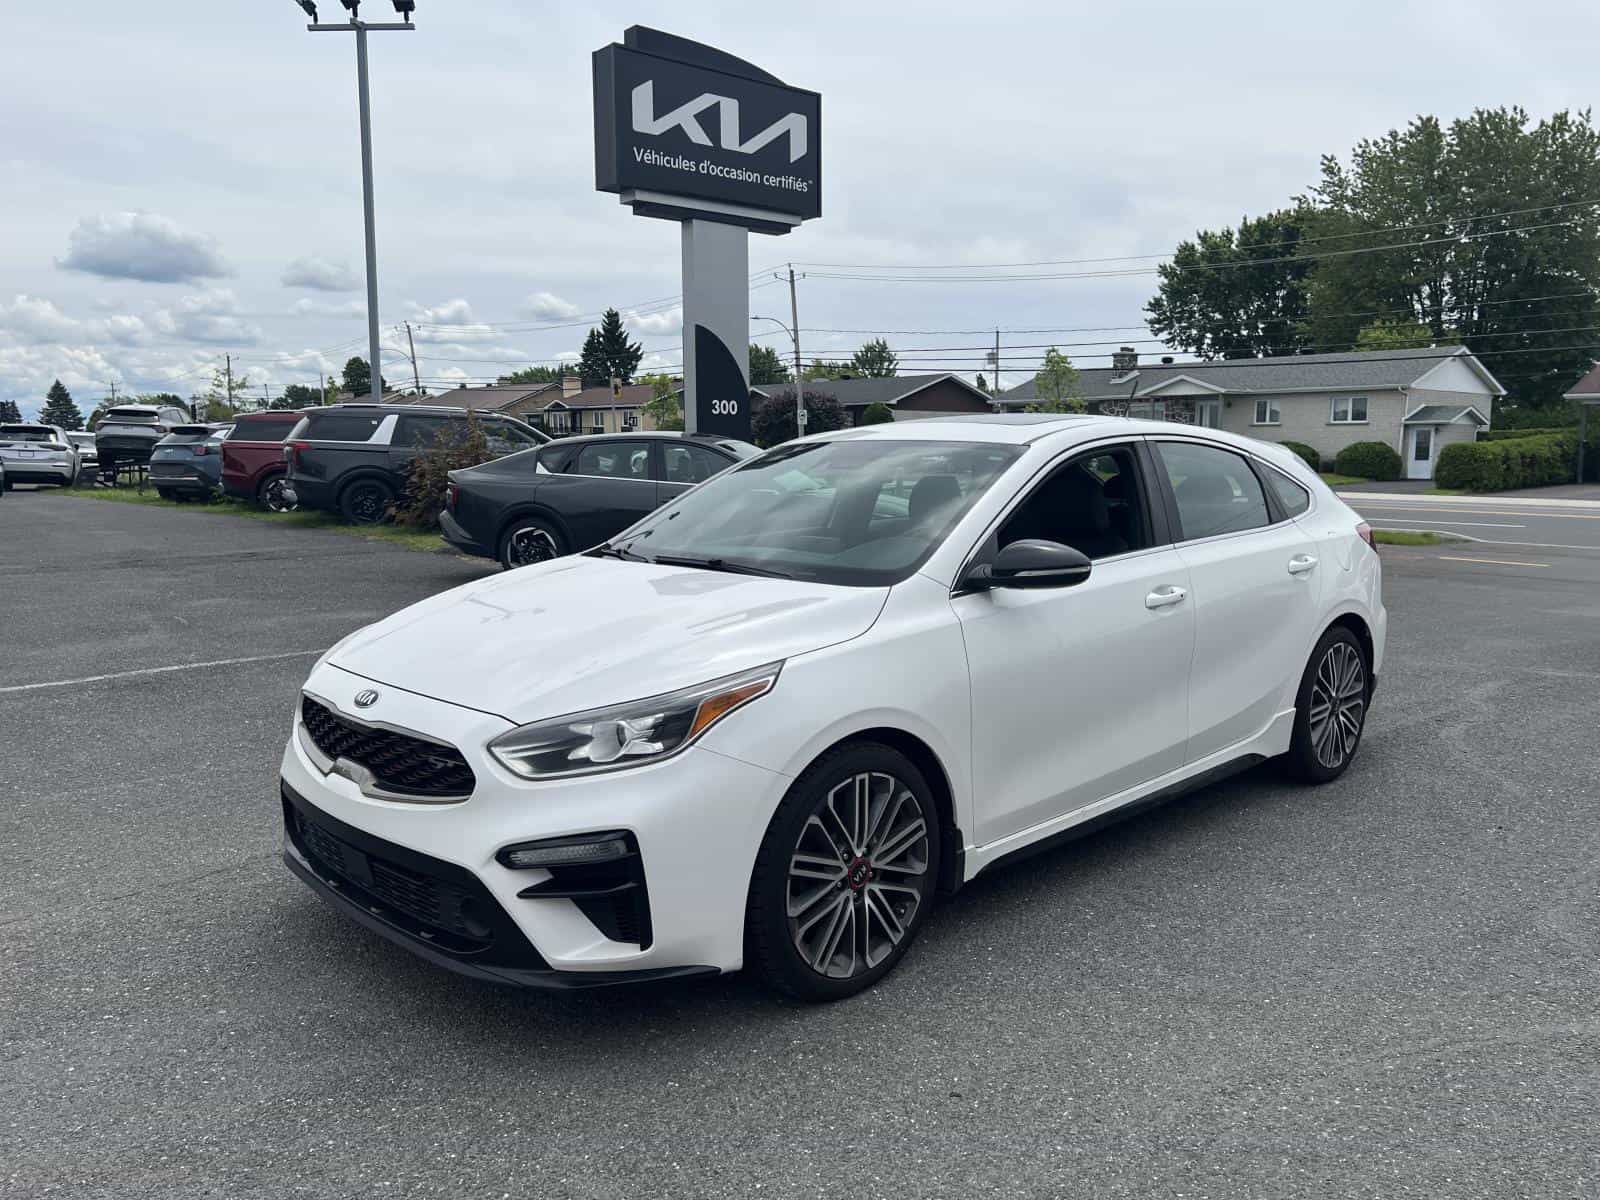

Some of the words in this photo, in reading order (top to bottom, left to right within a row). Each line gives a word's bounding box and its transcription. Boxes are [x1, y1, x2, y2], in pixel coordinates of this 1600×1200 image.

[633, 146, 696, 171] Véhicules
[699, 160, 760, 184] d'occasion
[711, 400, 738, 415] 300
